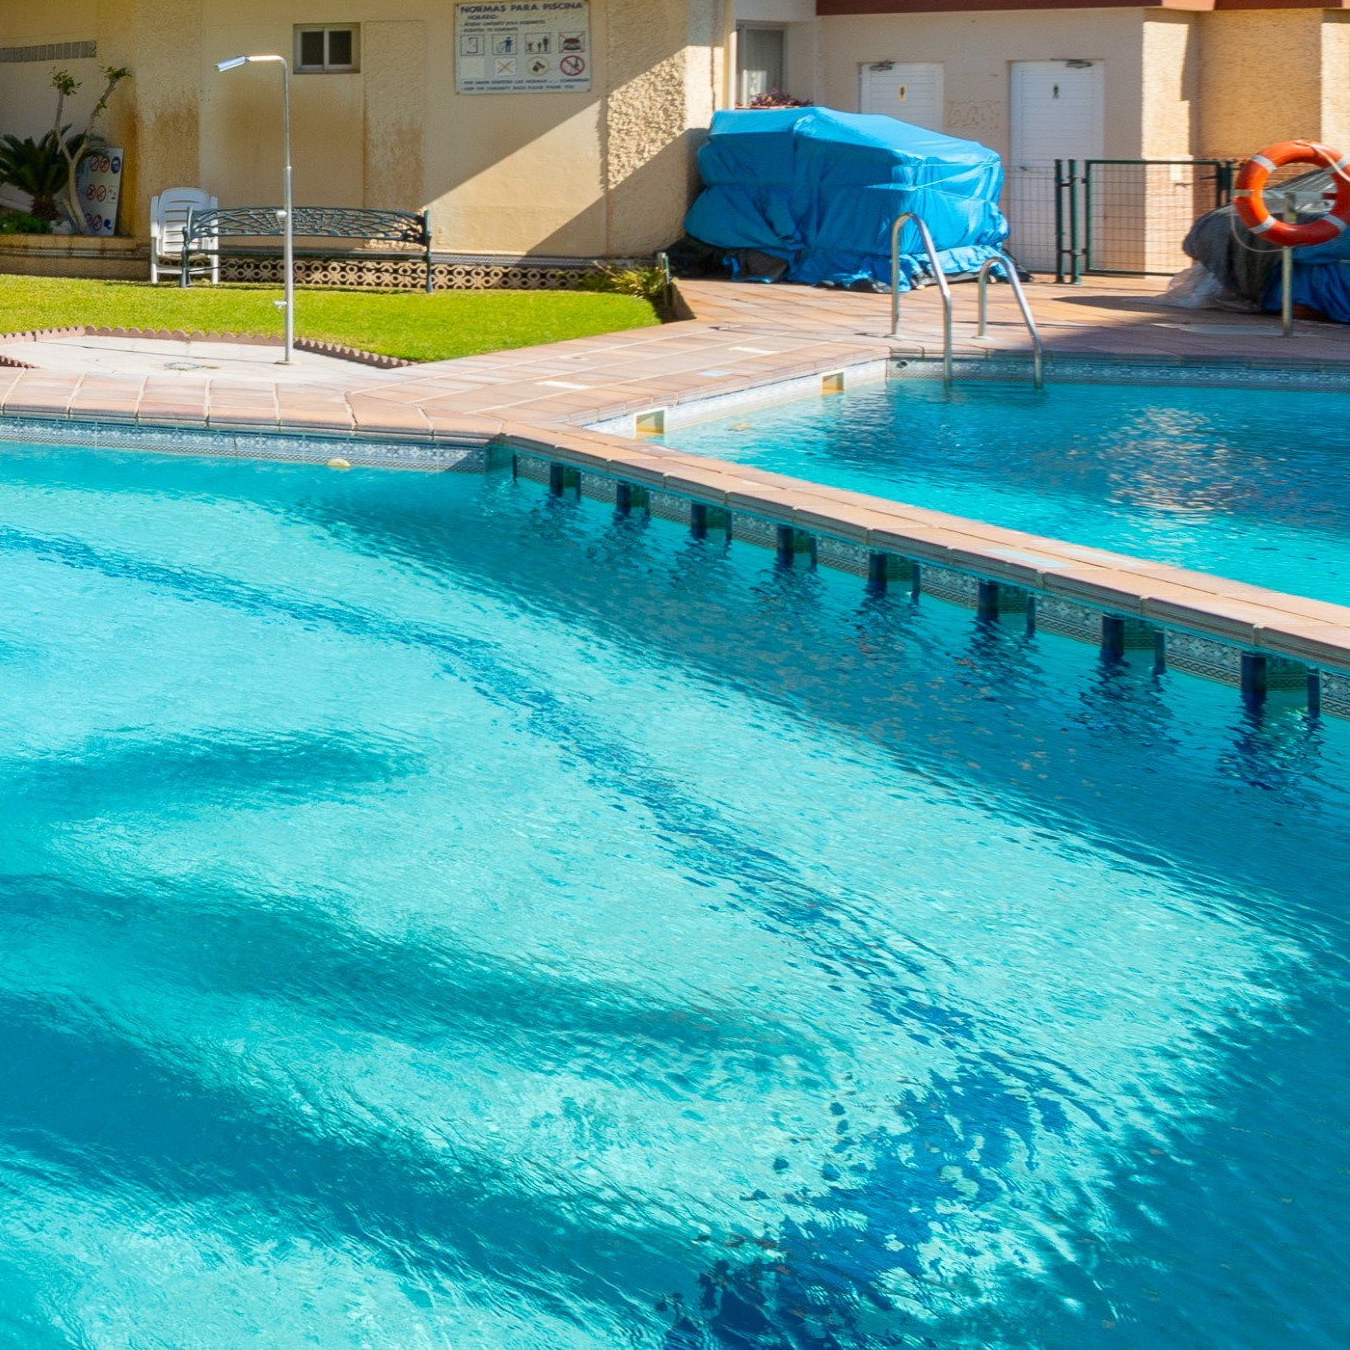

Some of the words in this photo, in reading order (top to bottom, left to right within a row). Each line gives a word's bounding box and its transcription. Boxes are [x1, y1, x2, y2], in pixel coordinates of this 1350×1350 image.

[460, 4, 506, 13] NORMAS
[510, 3, 538, 11] PARA
[542, 2, 583, 10] PISCINA
